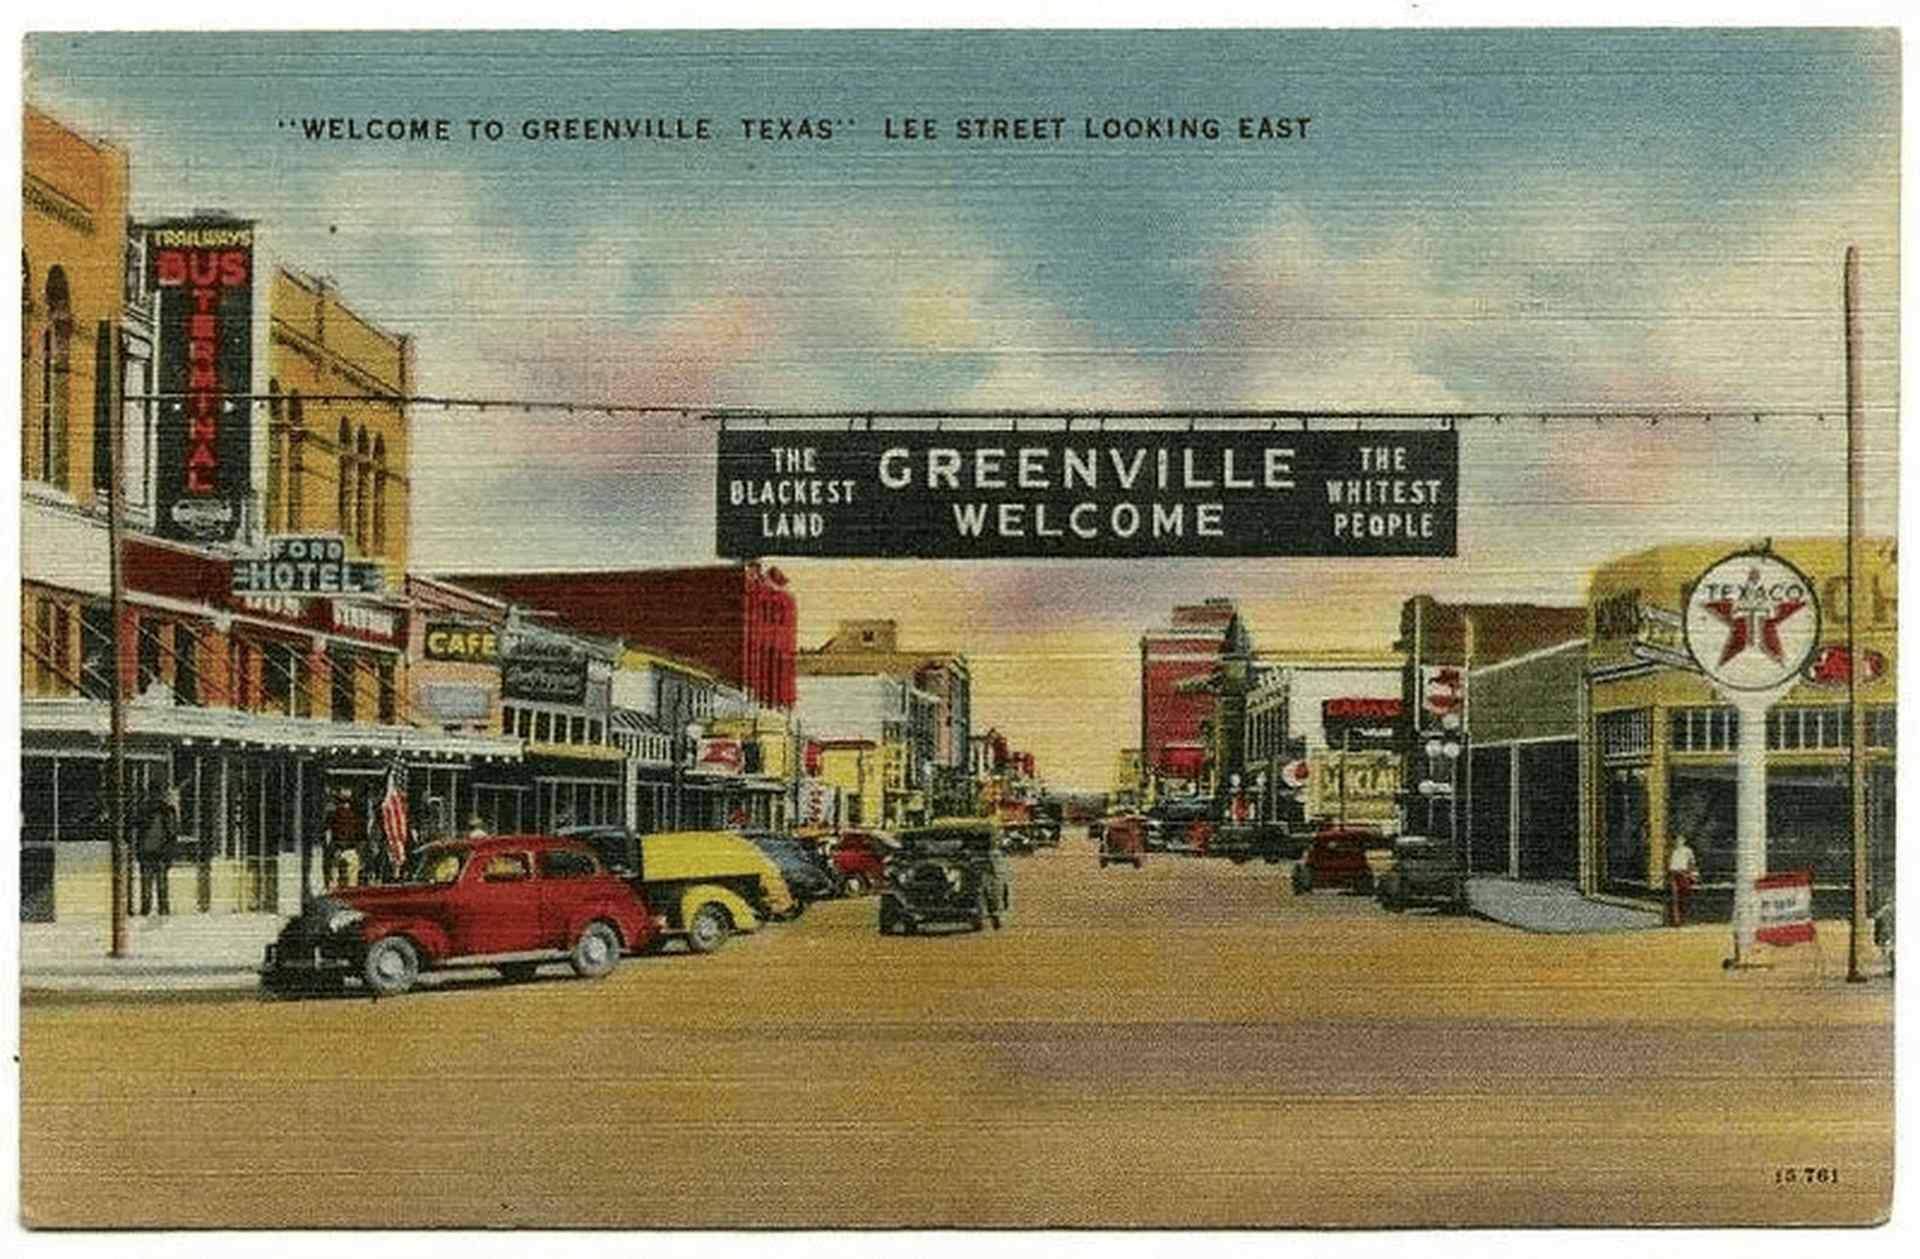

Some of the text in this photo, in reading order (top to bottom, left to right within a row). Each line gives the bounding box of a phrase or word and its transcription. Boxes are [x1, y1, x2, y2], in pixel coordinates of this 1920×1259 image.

[155, 250, 247, 287] BUS
[188, 288, 218, 492] TERMINAL
[771, 447, 817, 473] THE
[878, 447, 1296, 489] GREENVILLE
[1359, 447, 1407, 471] THE
[729, 479, 856, 505] BLACKEST
[1325, 479, 1442, 505] WHITEST
[762, 513, 825, 538] LAND
[953, 503, 1225, 539] WELCOME
[1333, 513, 1434, 538] PEOPLE
[271, 541, 343, 560] FORD
[250, 562, 362, 593] HOTEL
[1705, 583, 1805, 601] TEXACO
[427, 630, 497, 657] CAFE
